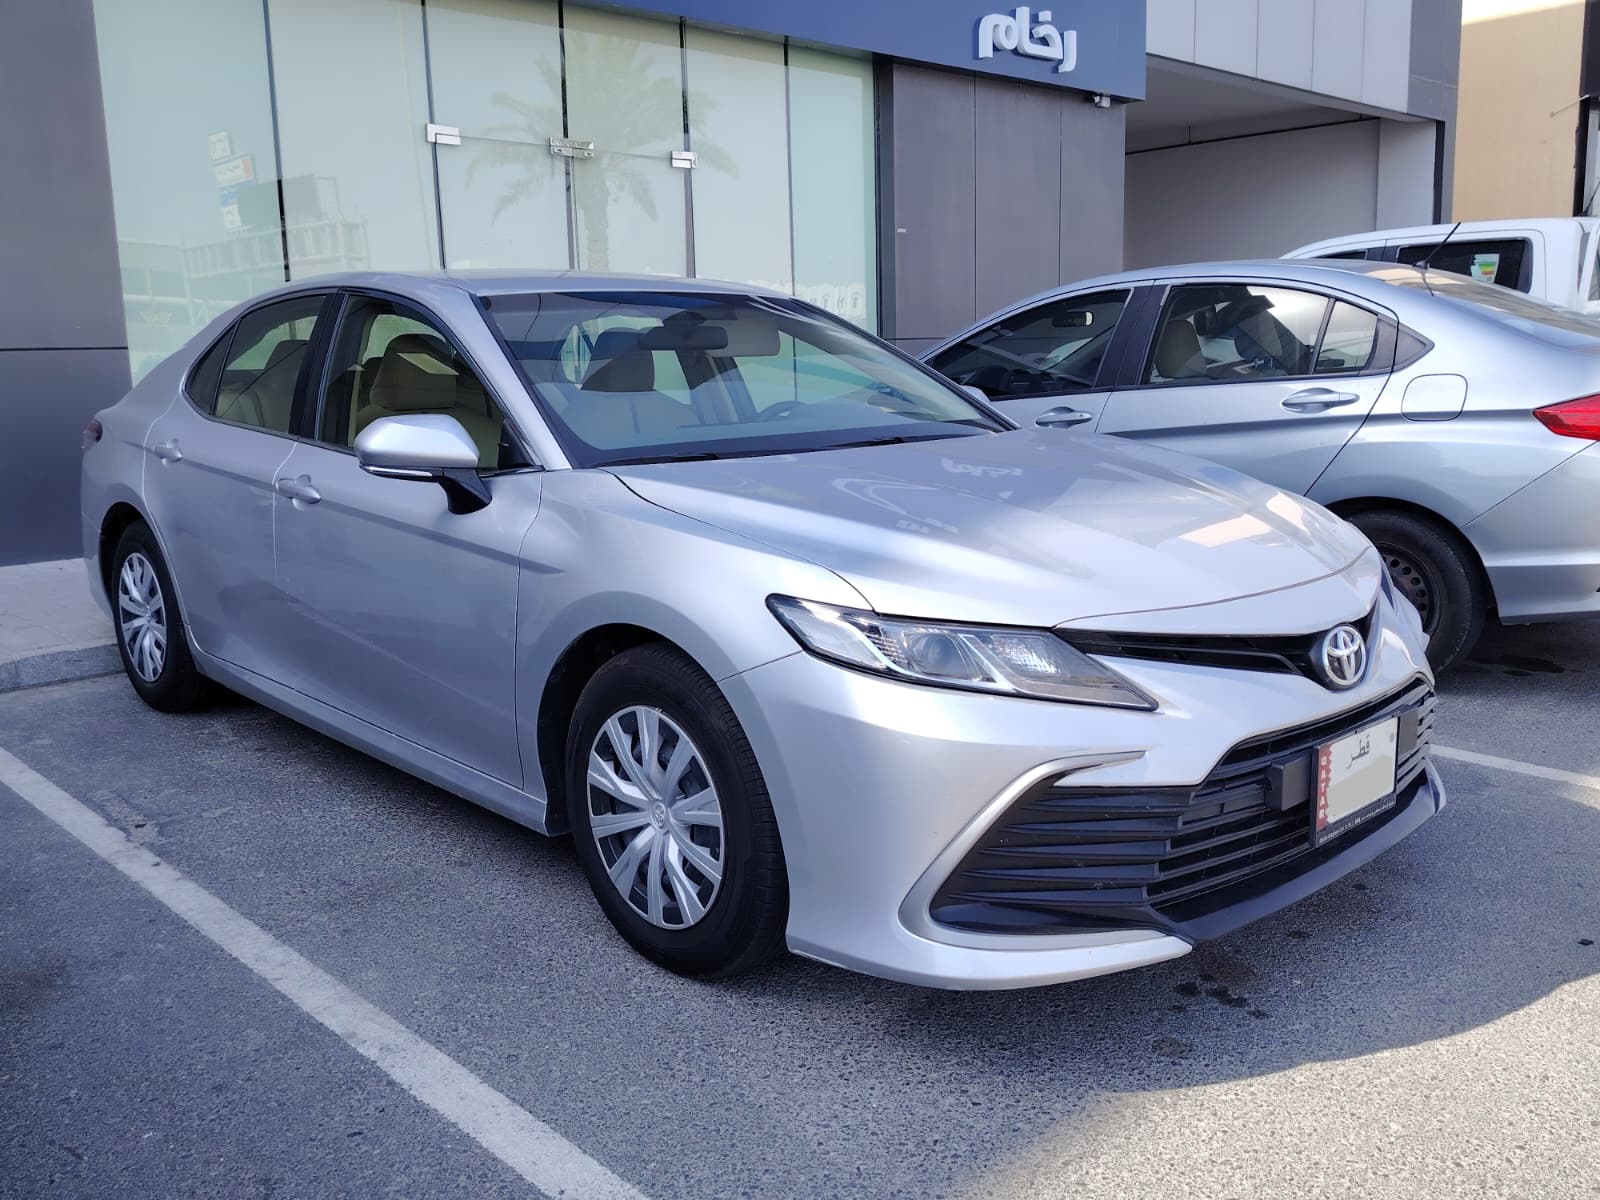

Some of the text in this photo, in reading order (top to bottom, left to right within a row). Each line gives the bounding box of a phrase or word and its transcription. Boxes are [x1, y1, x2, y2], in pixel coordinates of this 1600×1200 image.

[978, 6, 1077, 73] رخام
[1346, 734, 1371, 770] قطر
[1319, 756, 1328, 820] QATAR
